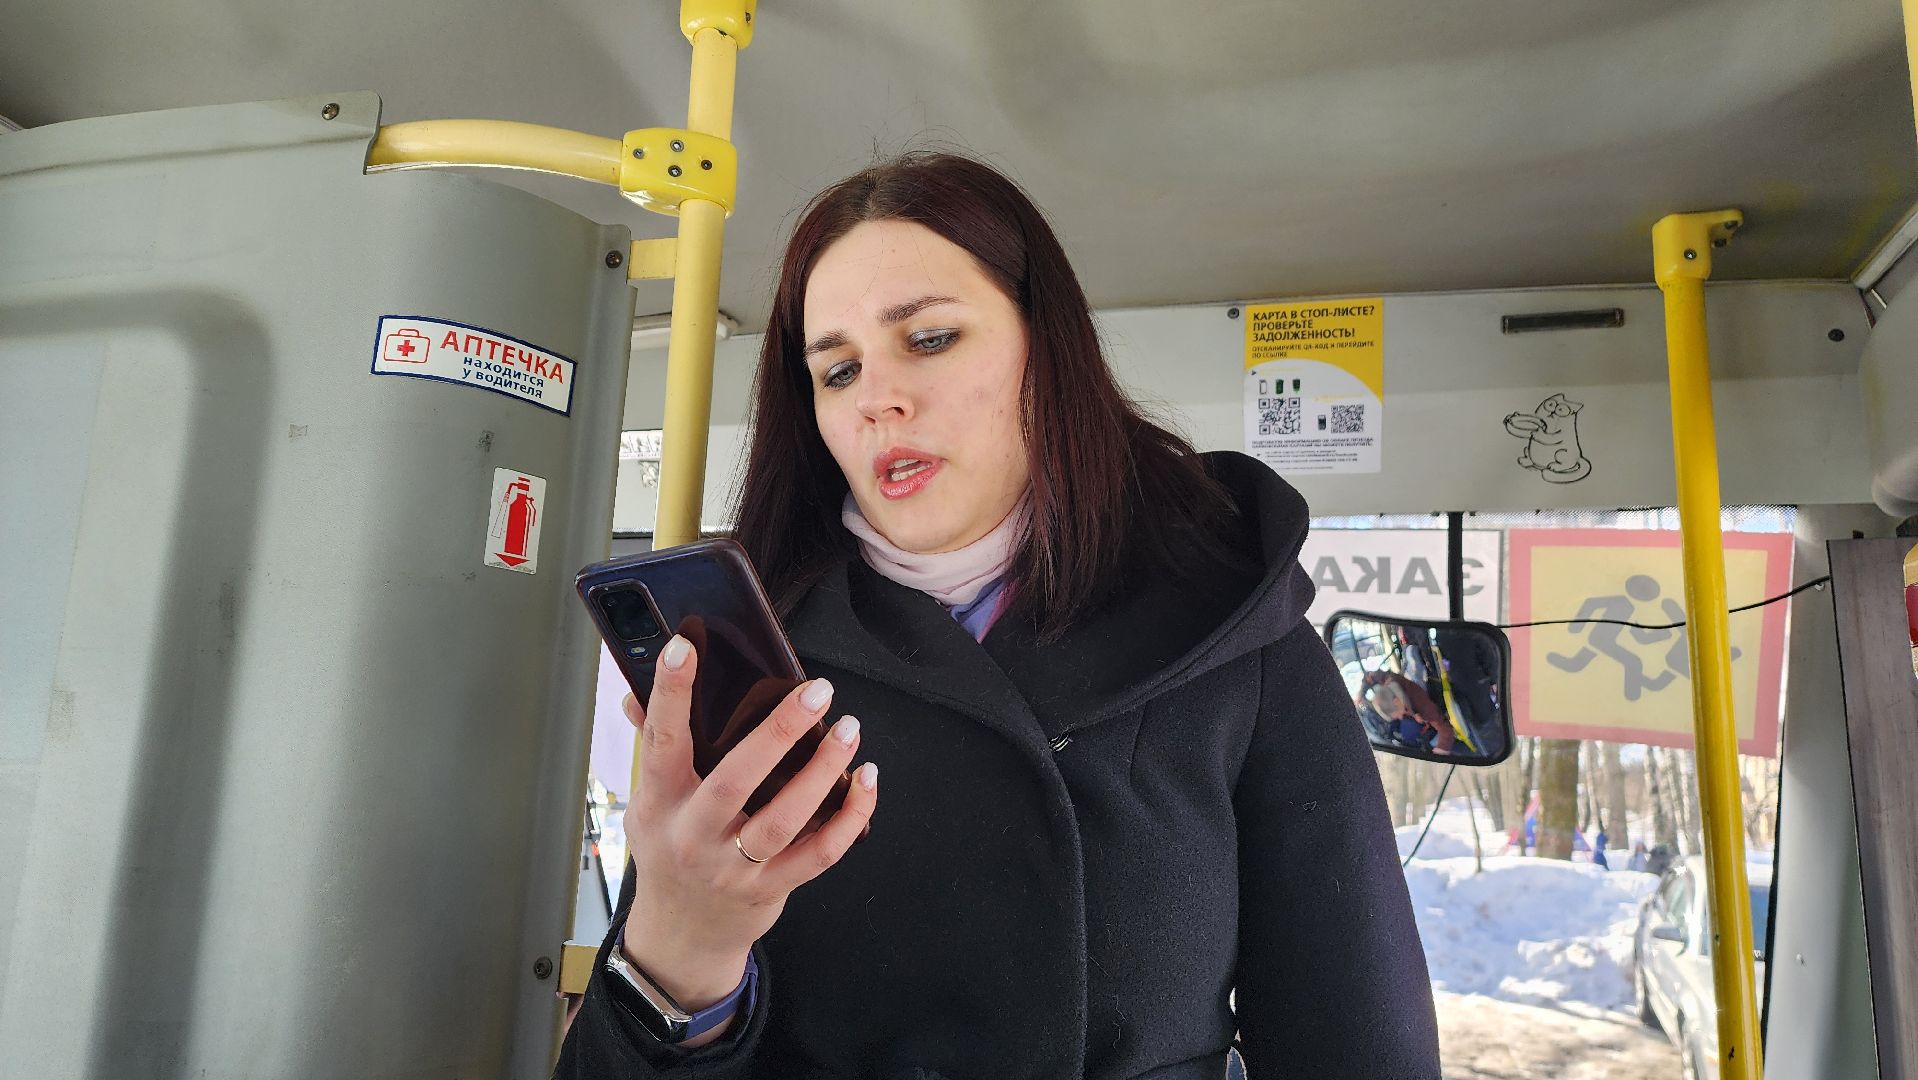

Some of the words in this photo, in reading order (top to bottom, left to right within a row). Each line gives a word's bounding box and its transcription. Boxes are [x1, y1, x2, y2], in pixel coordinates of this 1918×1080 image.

[1253, 311, 1287, 321] КАРТА
[1290, 310, 1297, 319] В
[1300, 305, 1375, 318] СТОП-ЛИСТЕ?
[1253, 320, 1313, 331] ПРОВЕРЬТЕ
[1253, 328, 1356, 342] ЗАДОЛЖЕННОСТЬ!
[440, 330, 564, 384] АПТЕЧКА
[462, 367, 472, 380] у
[475, 371, 543, 399] водителя
[463, 356, 545, 388] находится
